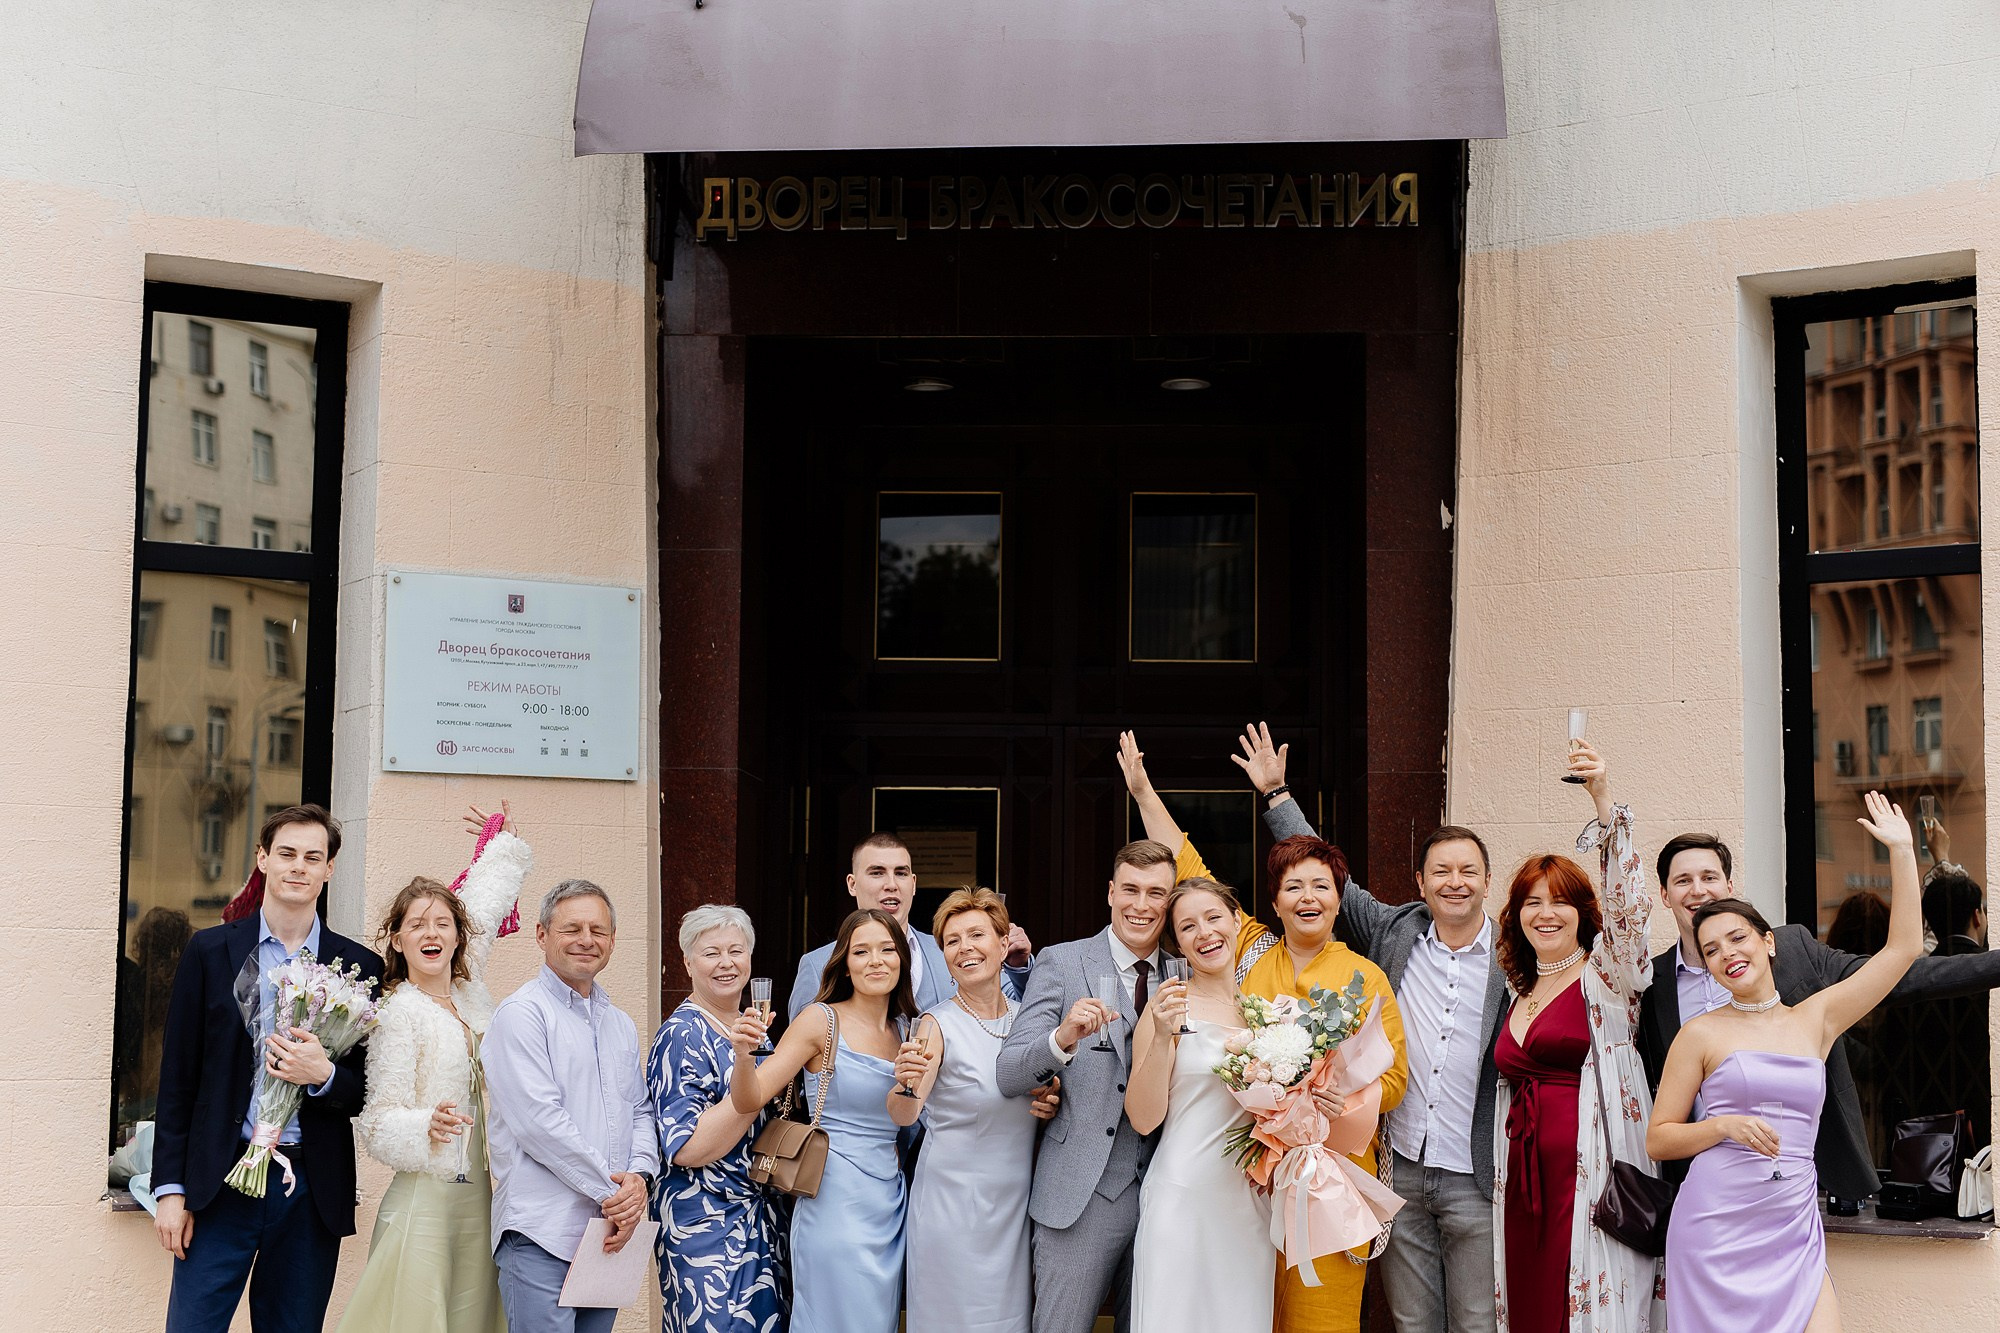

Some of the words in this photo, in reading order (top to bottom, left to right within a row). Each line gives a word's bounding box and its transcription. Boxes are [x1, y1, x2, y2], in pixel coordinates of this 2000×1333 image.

[695, 177, 908, 241] ДВОРЕЦ
[926, 172, 1420, 230] БРАКОСОЧЕТАНИЯ
[437, 640, 487, 656] Дворец
[490, 643, 591, 661] бракосочетания
[467, 680, 512, 694] РЕЖИМ
[515, 682, 561, 696] РАБОТЫ
[522, 703, 548, 716] 9:00
[559, 704, 590, 717] 18:00
[462, 745, 481, 753] ЗАГС
